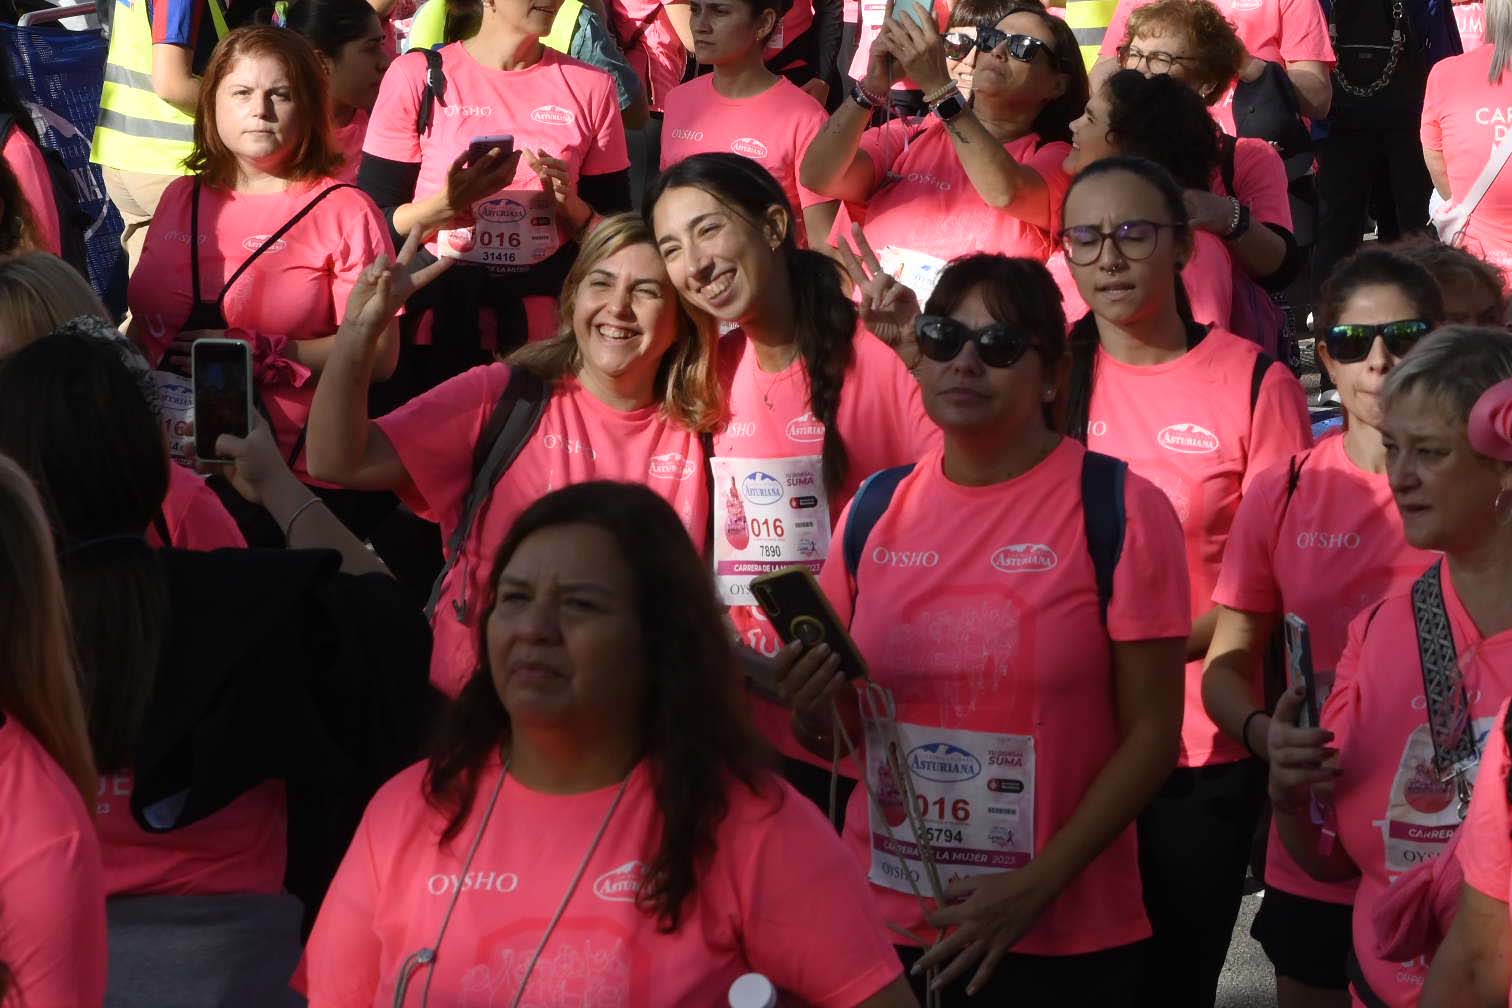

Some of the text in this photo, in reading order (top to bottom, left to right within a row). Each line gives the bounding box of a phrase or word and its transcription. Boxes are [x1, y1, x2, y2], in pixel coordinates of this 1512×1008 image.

[480, 231, 521, 248] 016
[482, 251, 516, 262] 31416
[1164, 432, 1215, 449] ASTURIANA
[787, 477, 815, 487] SUMA
[744, 484, 781, 499] ASTURIANA
[751, 518, 785, 539] 016
[1296, 531, 1361, 551] OYSHO
[760, 545, 781, 559] 7890
[872, 545, 940, 570] OYSHO
[734, 563, 763, 573] CARRERA
[997, 552, 1052, 569] ASTURIANA
[912, 754, 975, 776] ASTURIANA
[988, 756, 1023, 768] SUMA
[1408, 827, 1454, 840] CARRER
[952, 852, 988, 863] MUJER
[428, 871, 518, 896] OYSHO
